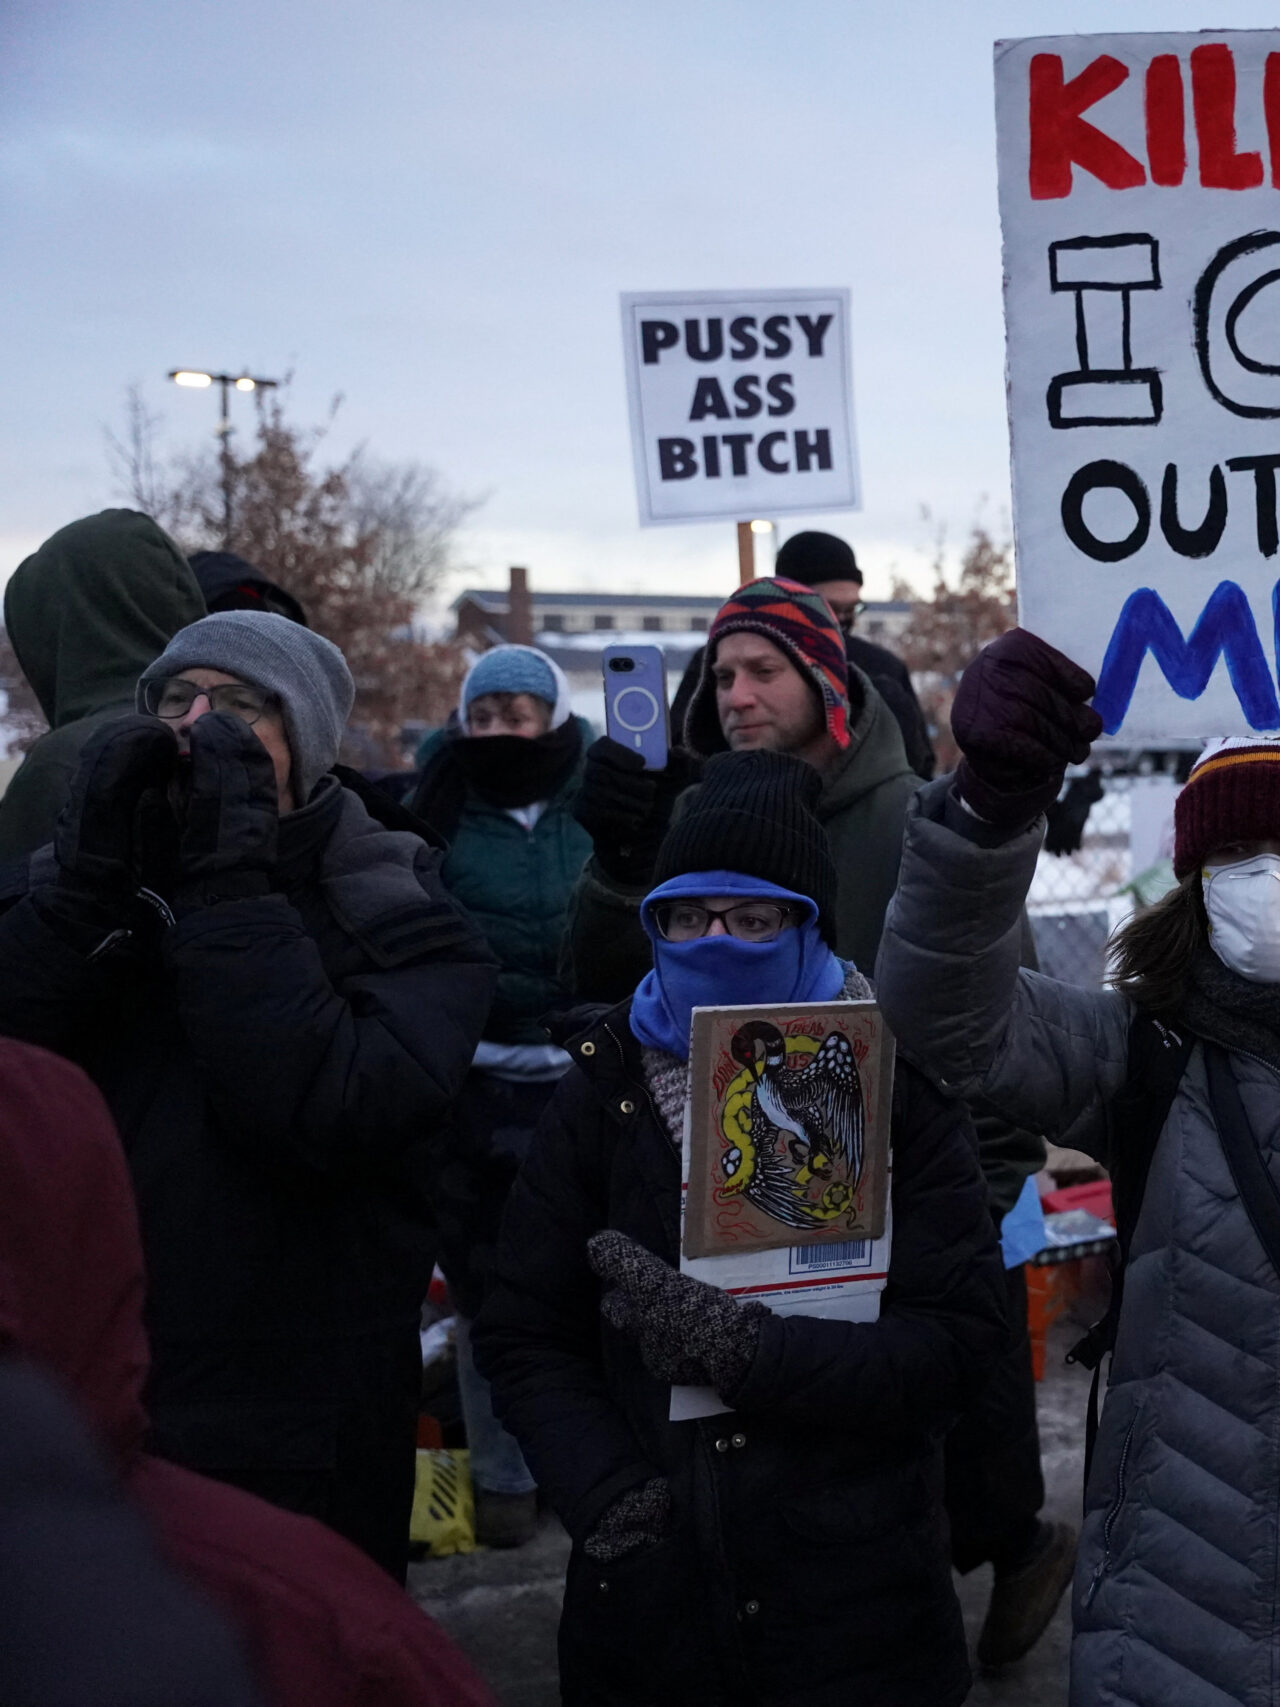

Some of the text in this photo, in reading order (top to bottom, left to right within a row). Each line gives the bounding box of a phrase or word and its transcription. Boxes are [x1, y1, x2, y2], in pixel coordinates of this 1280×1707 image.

[641, 313, 834, 365] PUSSY
[689, 373, 796, 422] ASS
[657, 429, 833, 482] BITCH
[787, 1055, 810, 1069] US
